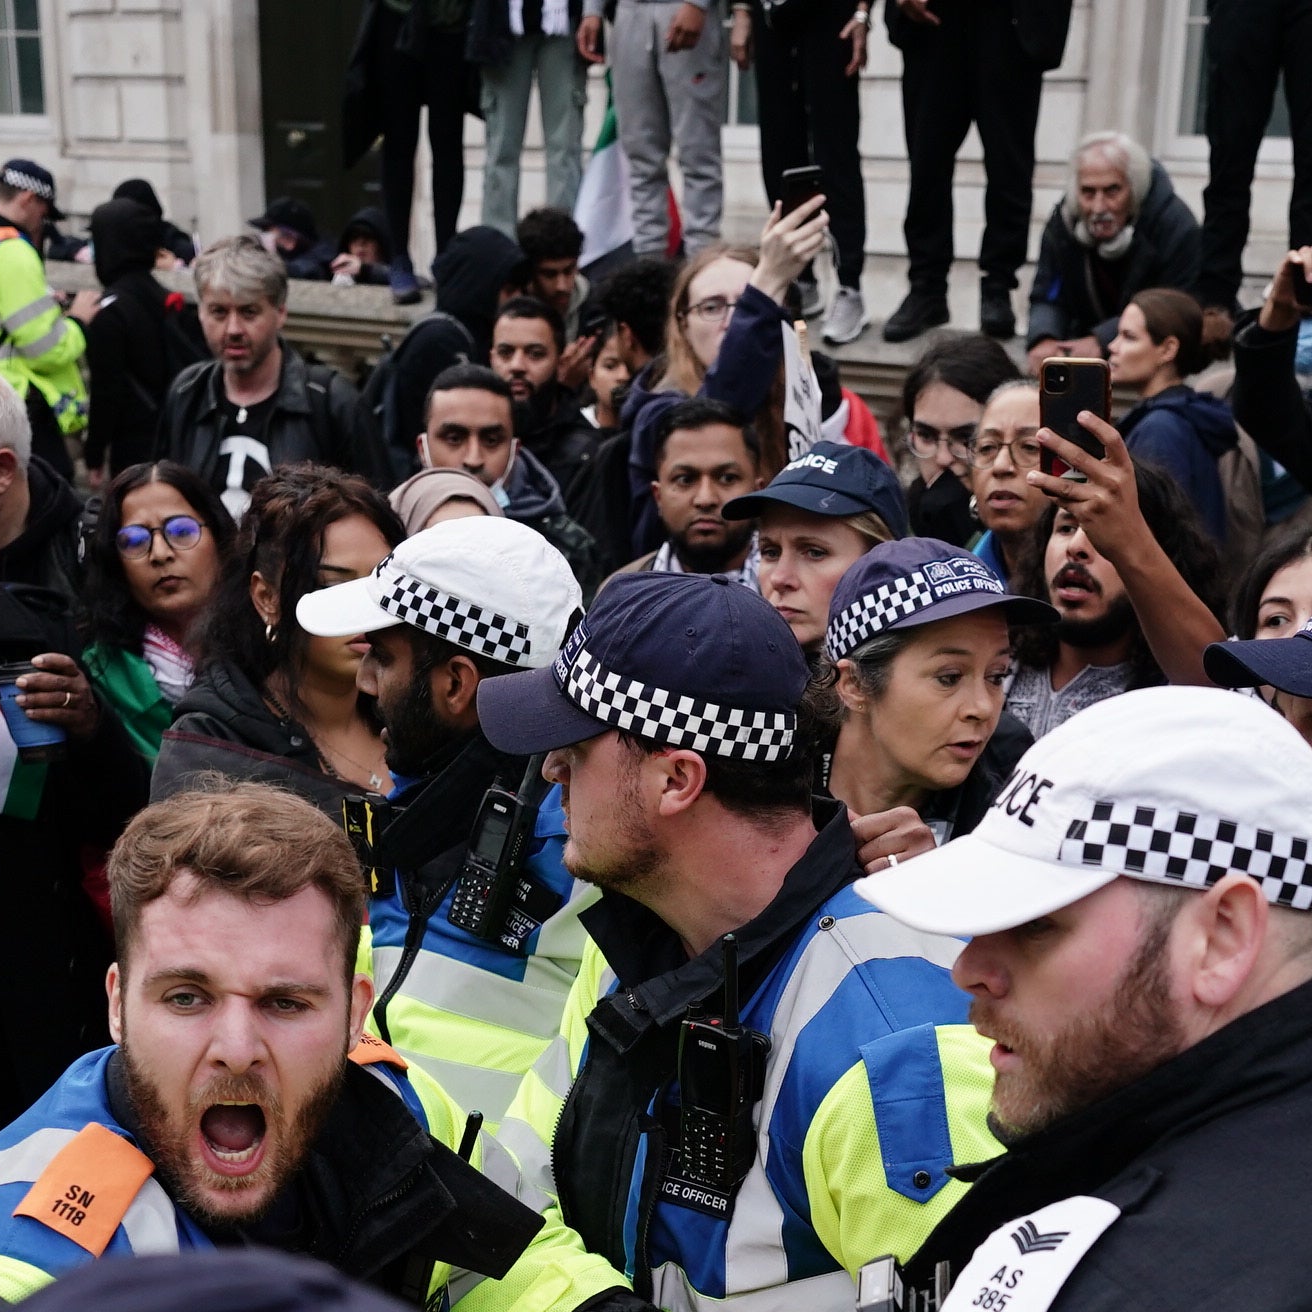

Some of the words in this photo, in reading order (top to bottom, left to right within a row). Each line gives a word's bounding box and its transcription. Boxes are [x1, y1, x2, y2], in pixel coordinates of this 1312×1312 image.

[934, 579, 972, 597] POLICE
[65, 1184, 96, 1209] SN
[681, 1187, 729, 1212] OFFICER
[51, 1199, 86, 1226] 1118
[990, 1265, 1024, 1289] AS
